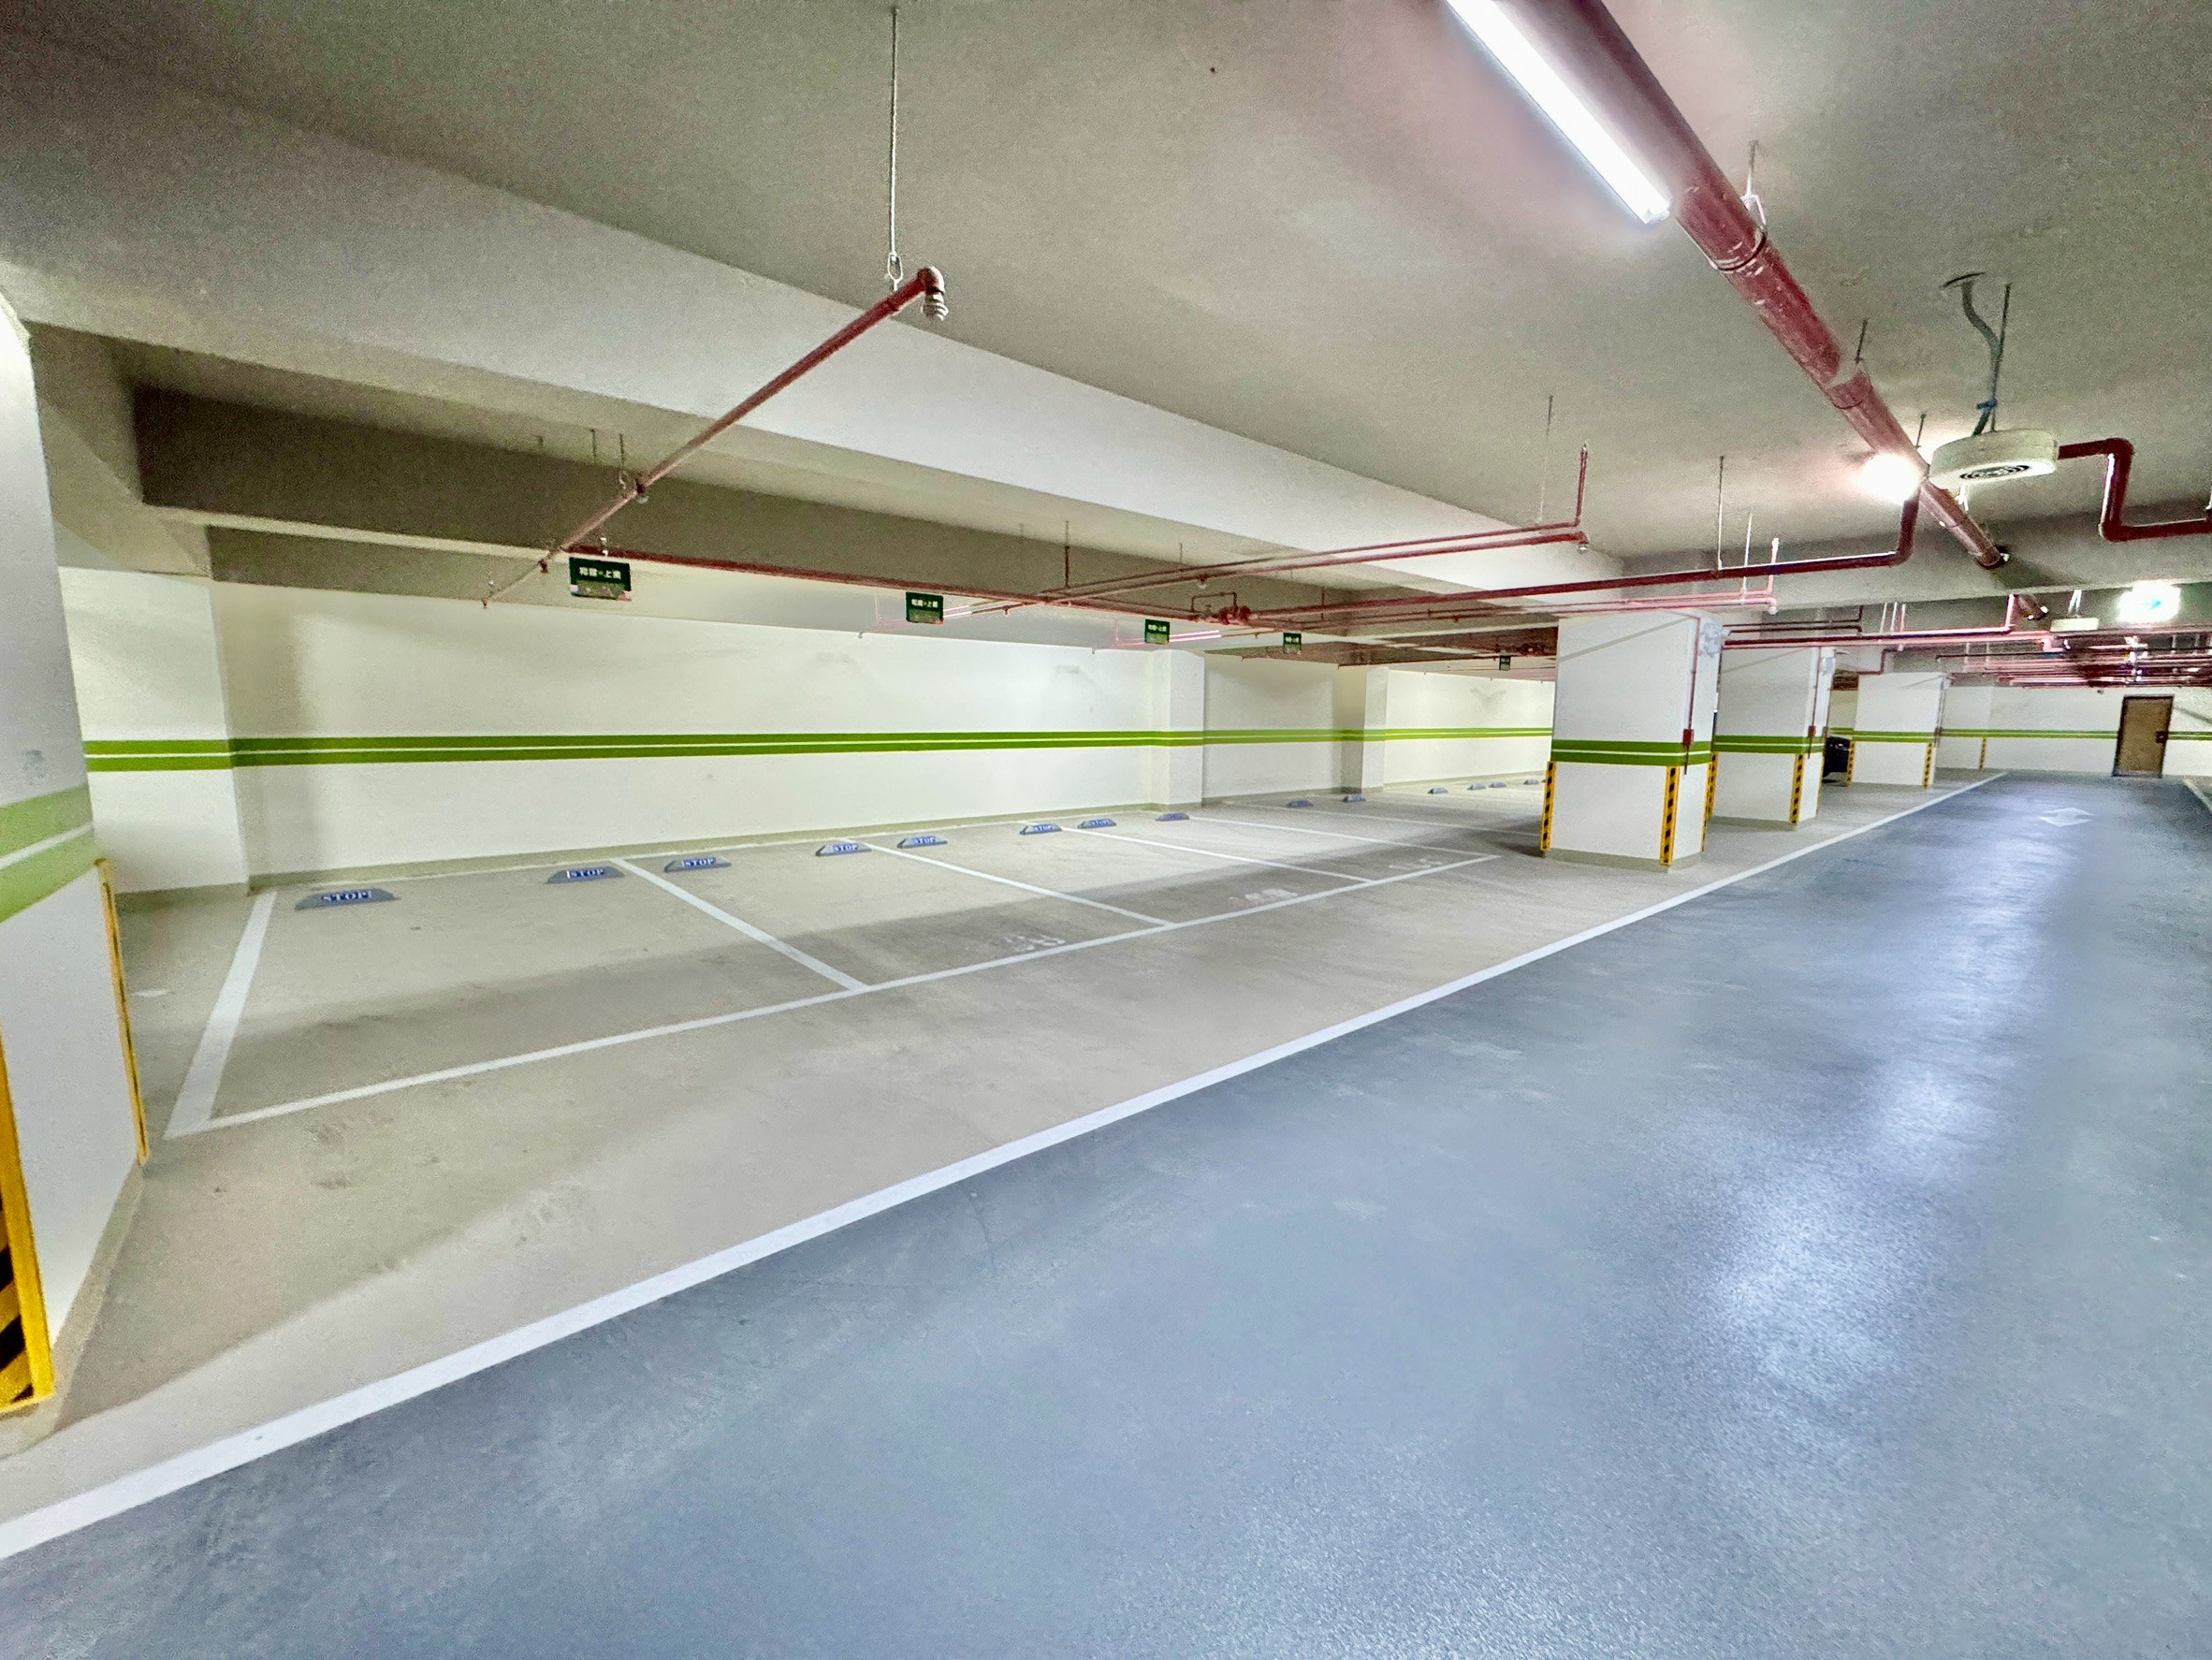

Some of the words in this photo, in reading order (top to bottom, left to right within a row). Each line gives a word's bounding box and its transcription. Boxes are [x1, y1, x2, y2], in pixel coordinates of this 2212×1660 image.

[834, 844, 858, 852] STOP
[685, 858, 714, 867] STOP
[572, 868, 604, 878] STOP
[323, 892, 369, 902] STOP
